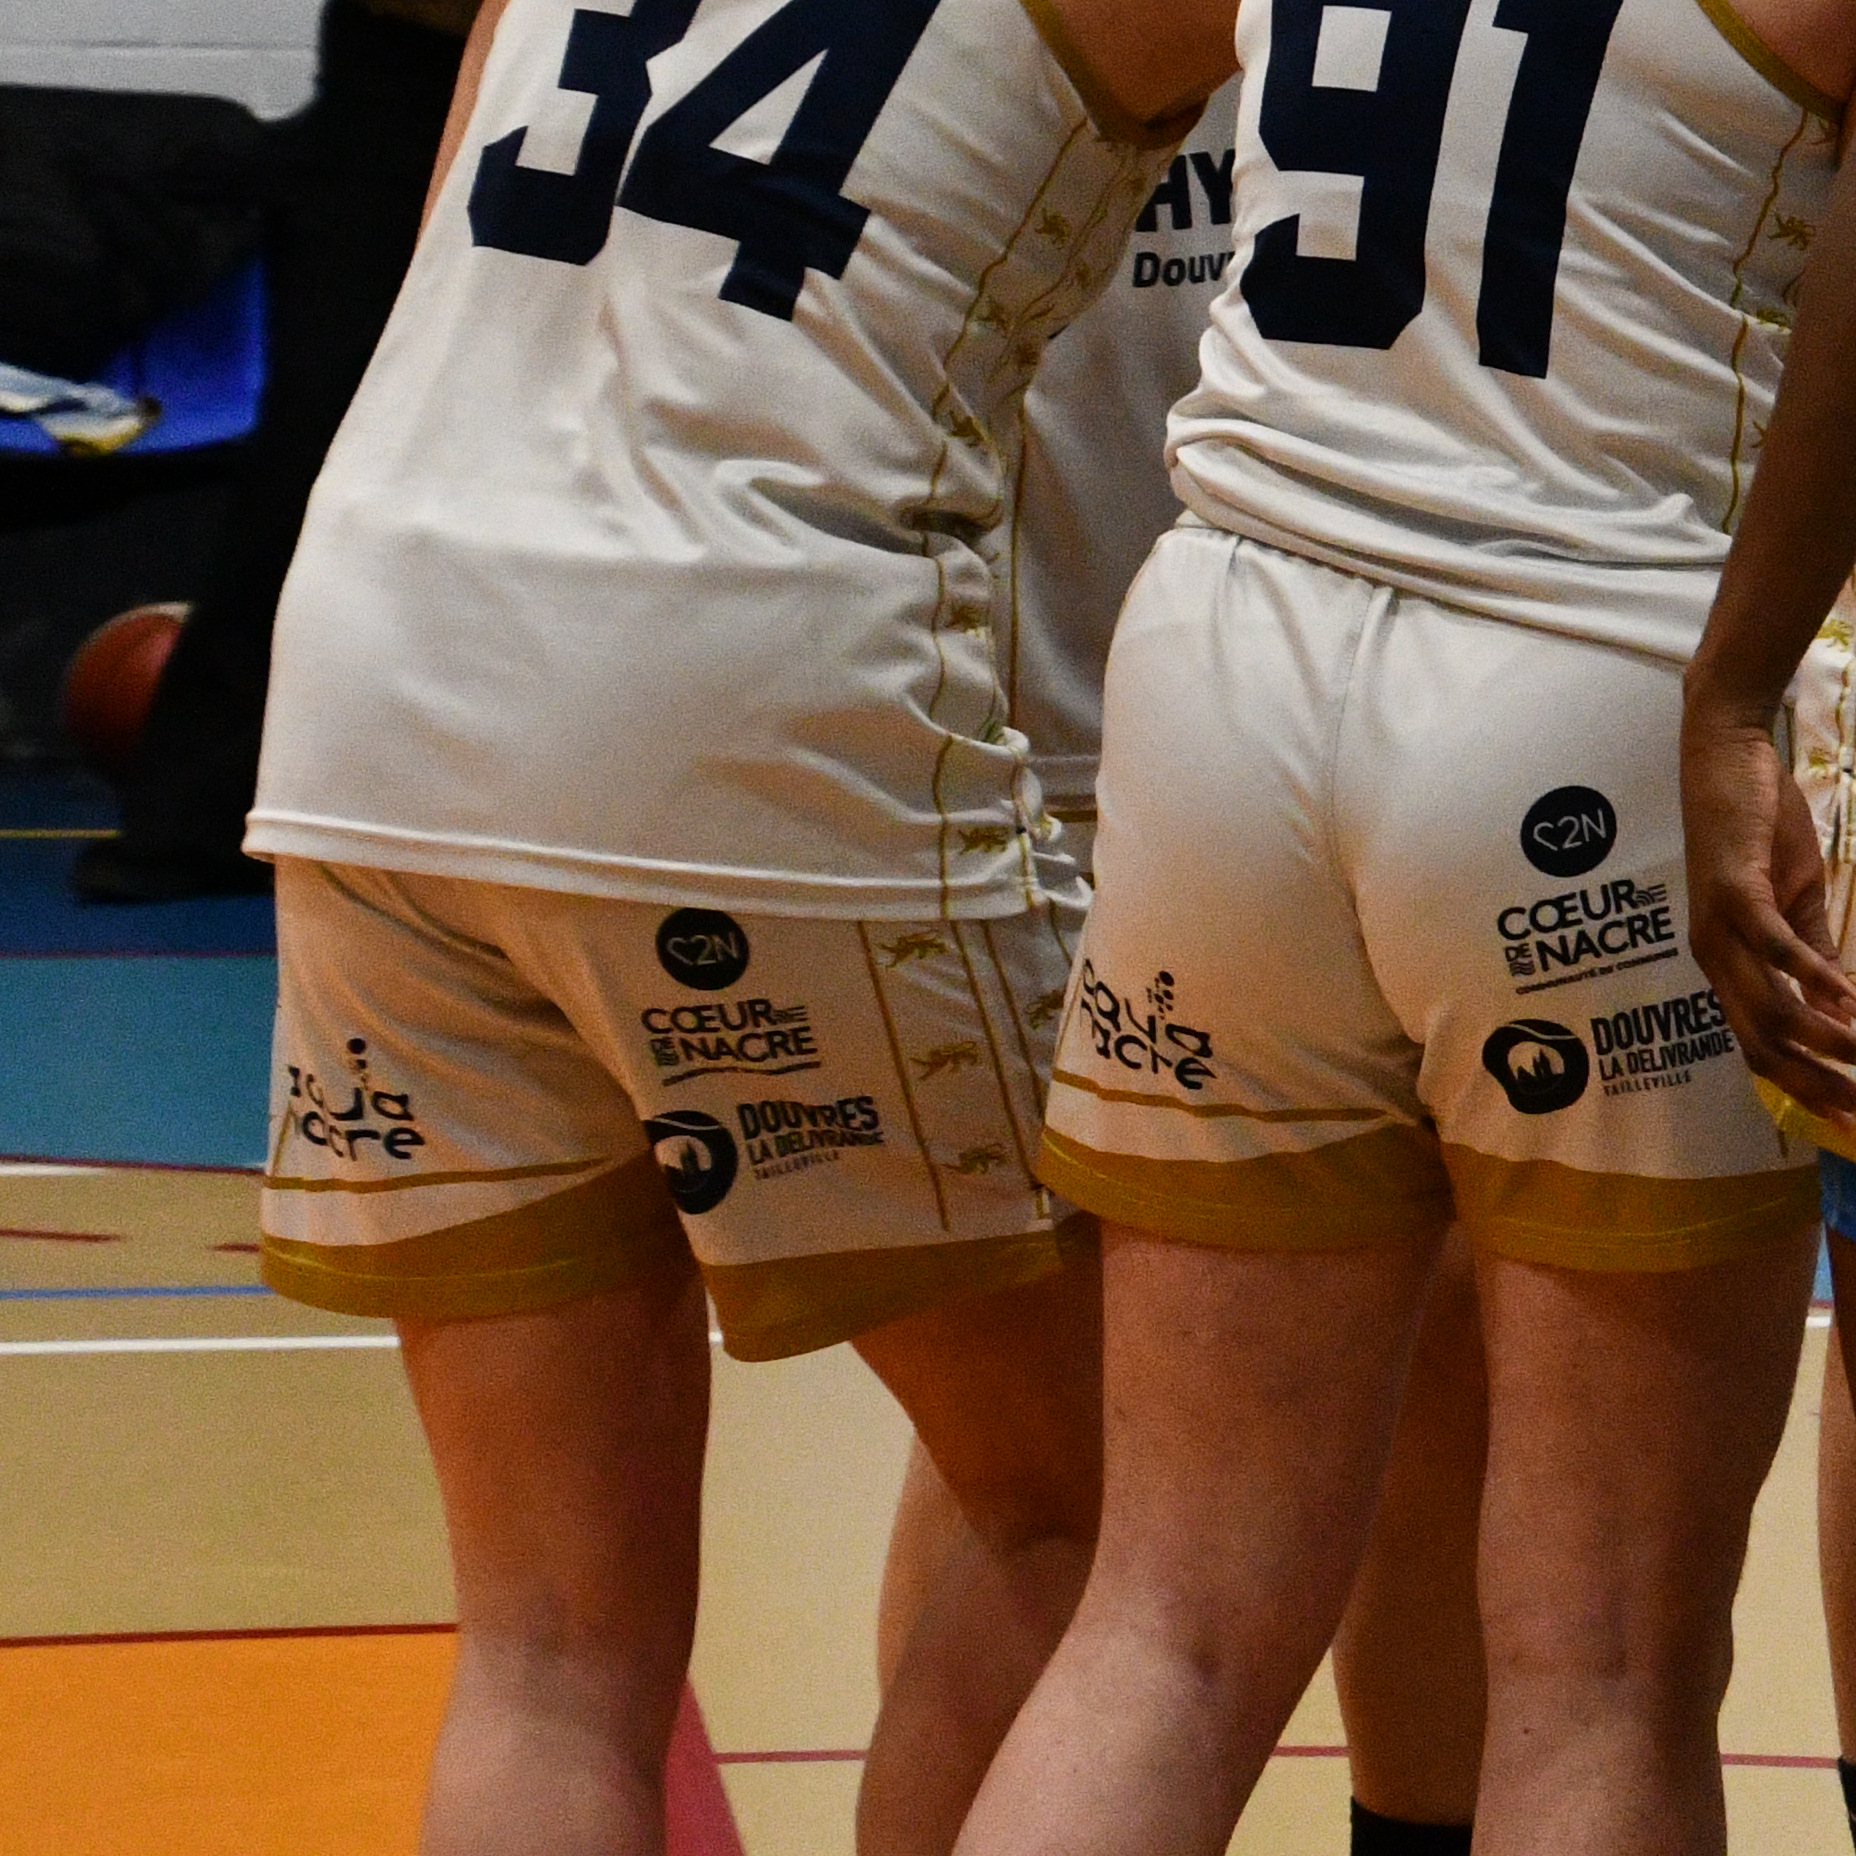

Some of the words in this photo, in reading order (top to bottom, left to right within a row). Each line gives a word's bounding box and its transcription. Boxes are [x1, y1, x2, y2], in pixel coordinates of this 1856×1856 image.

[1535, 905, 1676, 972] NACRE
[680, 1025, 819, 1063] NACRE
[1589, 988, 1727, 1056] DOUVRES
[1599, 1056, 1625, 1081] LA
